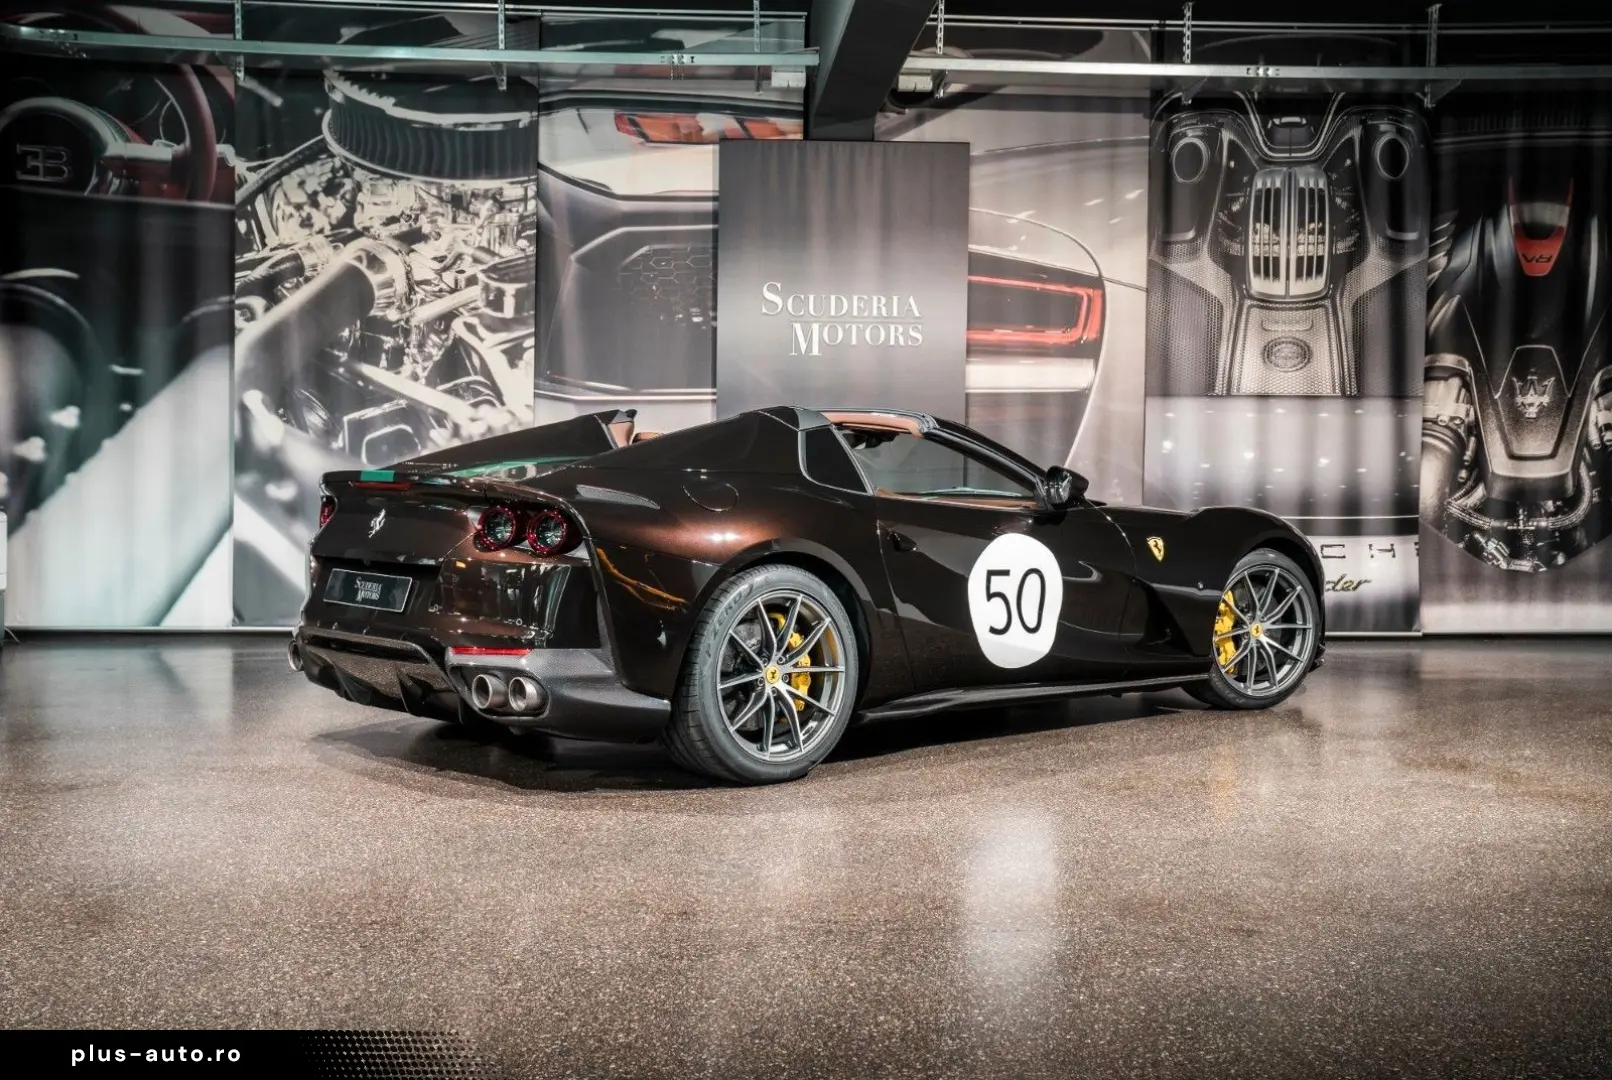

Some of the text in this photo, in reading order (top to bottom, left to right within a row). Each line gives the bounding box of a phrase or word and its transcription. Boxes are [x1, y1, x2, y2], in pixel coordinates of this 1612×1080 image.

[762, 281, 922, 318] SCUDERIA
[789, 322, 923, 356] MOTORS
[985, 567, 1046, 636] 50
